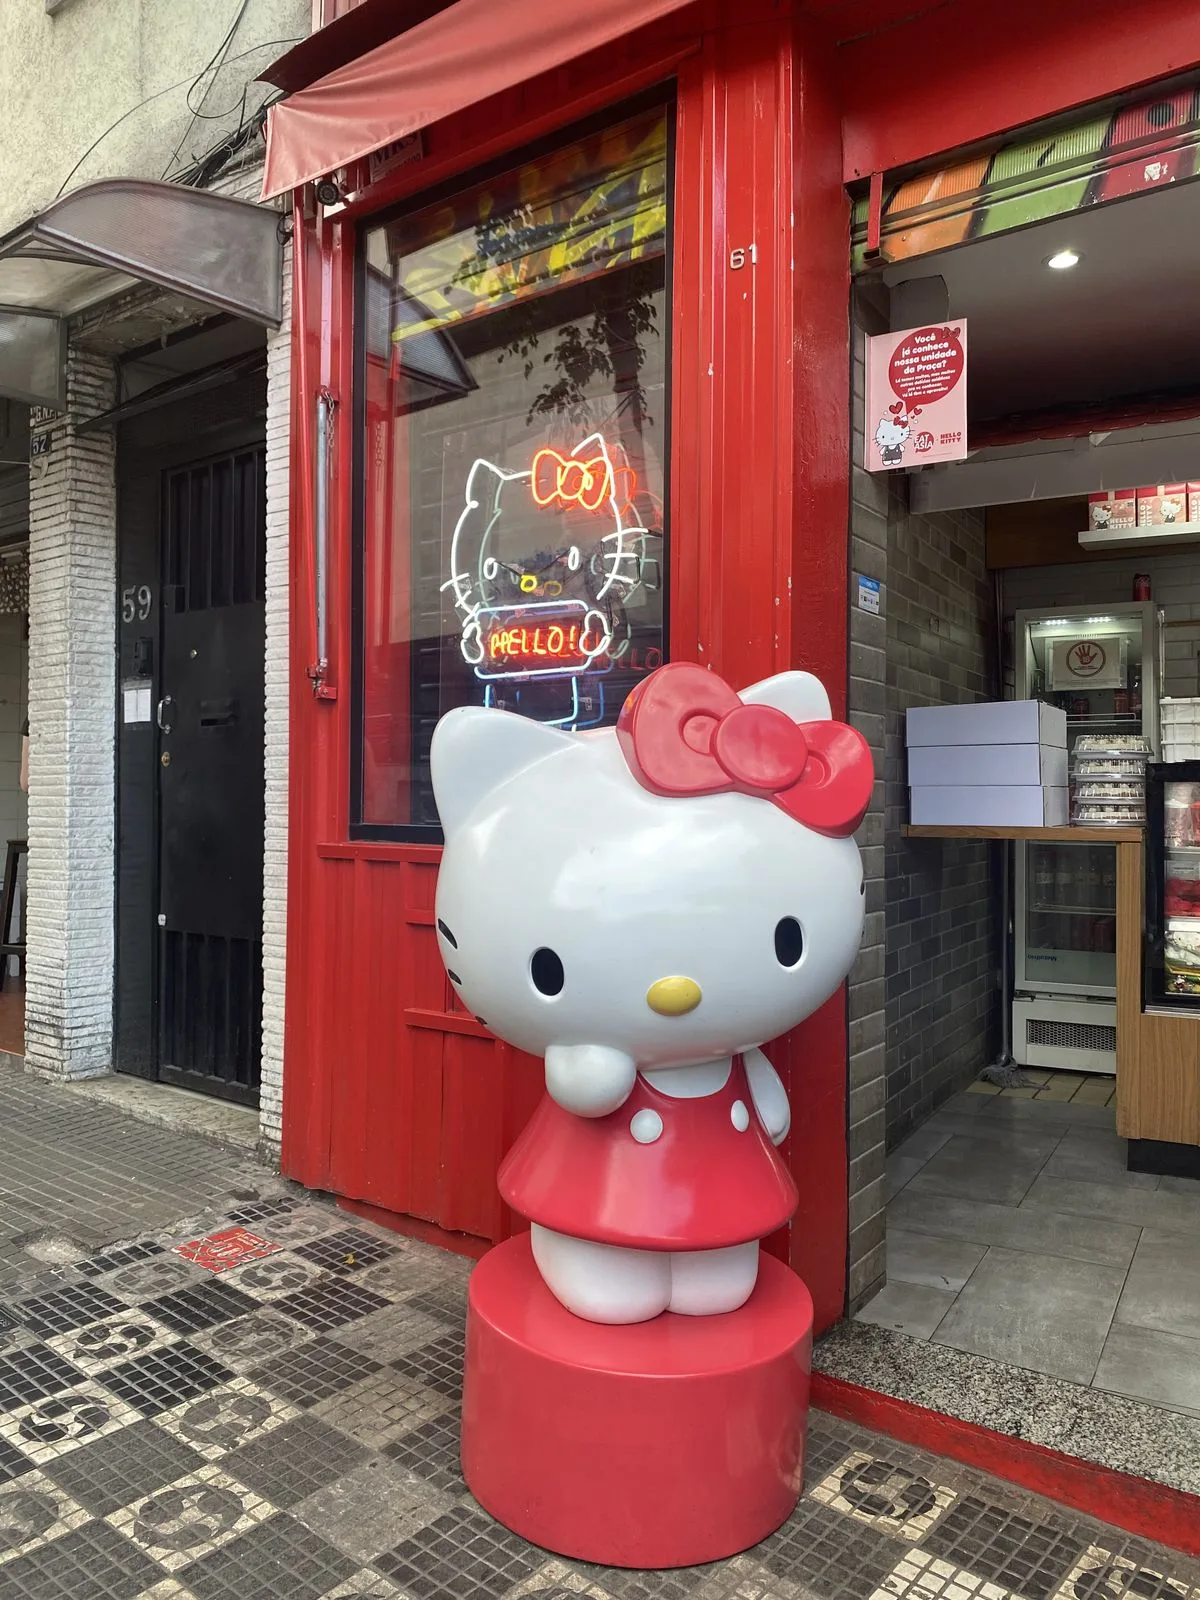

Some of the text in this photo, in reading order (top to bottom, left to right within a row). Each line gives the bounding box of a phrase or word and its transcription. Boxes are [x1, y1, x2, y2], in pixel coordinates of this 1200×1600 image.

[730, 243, 757, 270] 61
[914, 333, 936, 344] Você
[902, 341, 949, 358] já conhece
[894, 349, 957, 367] nossa unidade
[904, 360, 947, 375] da Praça?
[915, 434, 930, 443] EAT
[915, 441, 934, 449] ASIA
[940, 437, 962, 445] KITTY
[122, 585, 151, 623] 59
